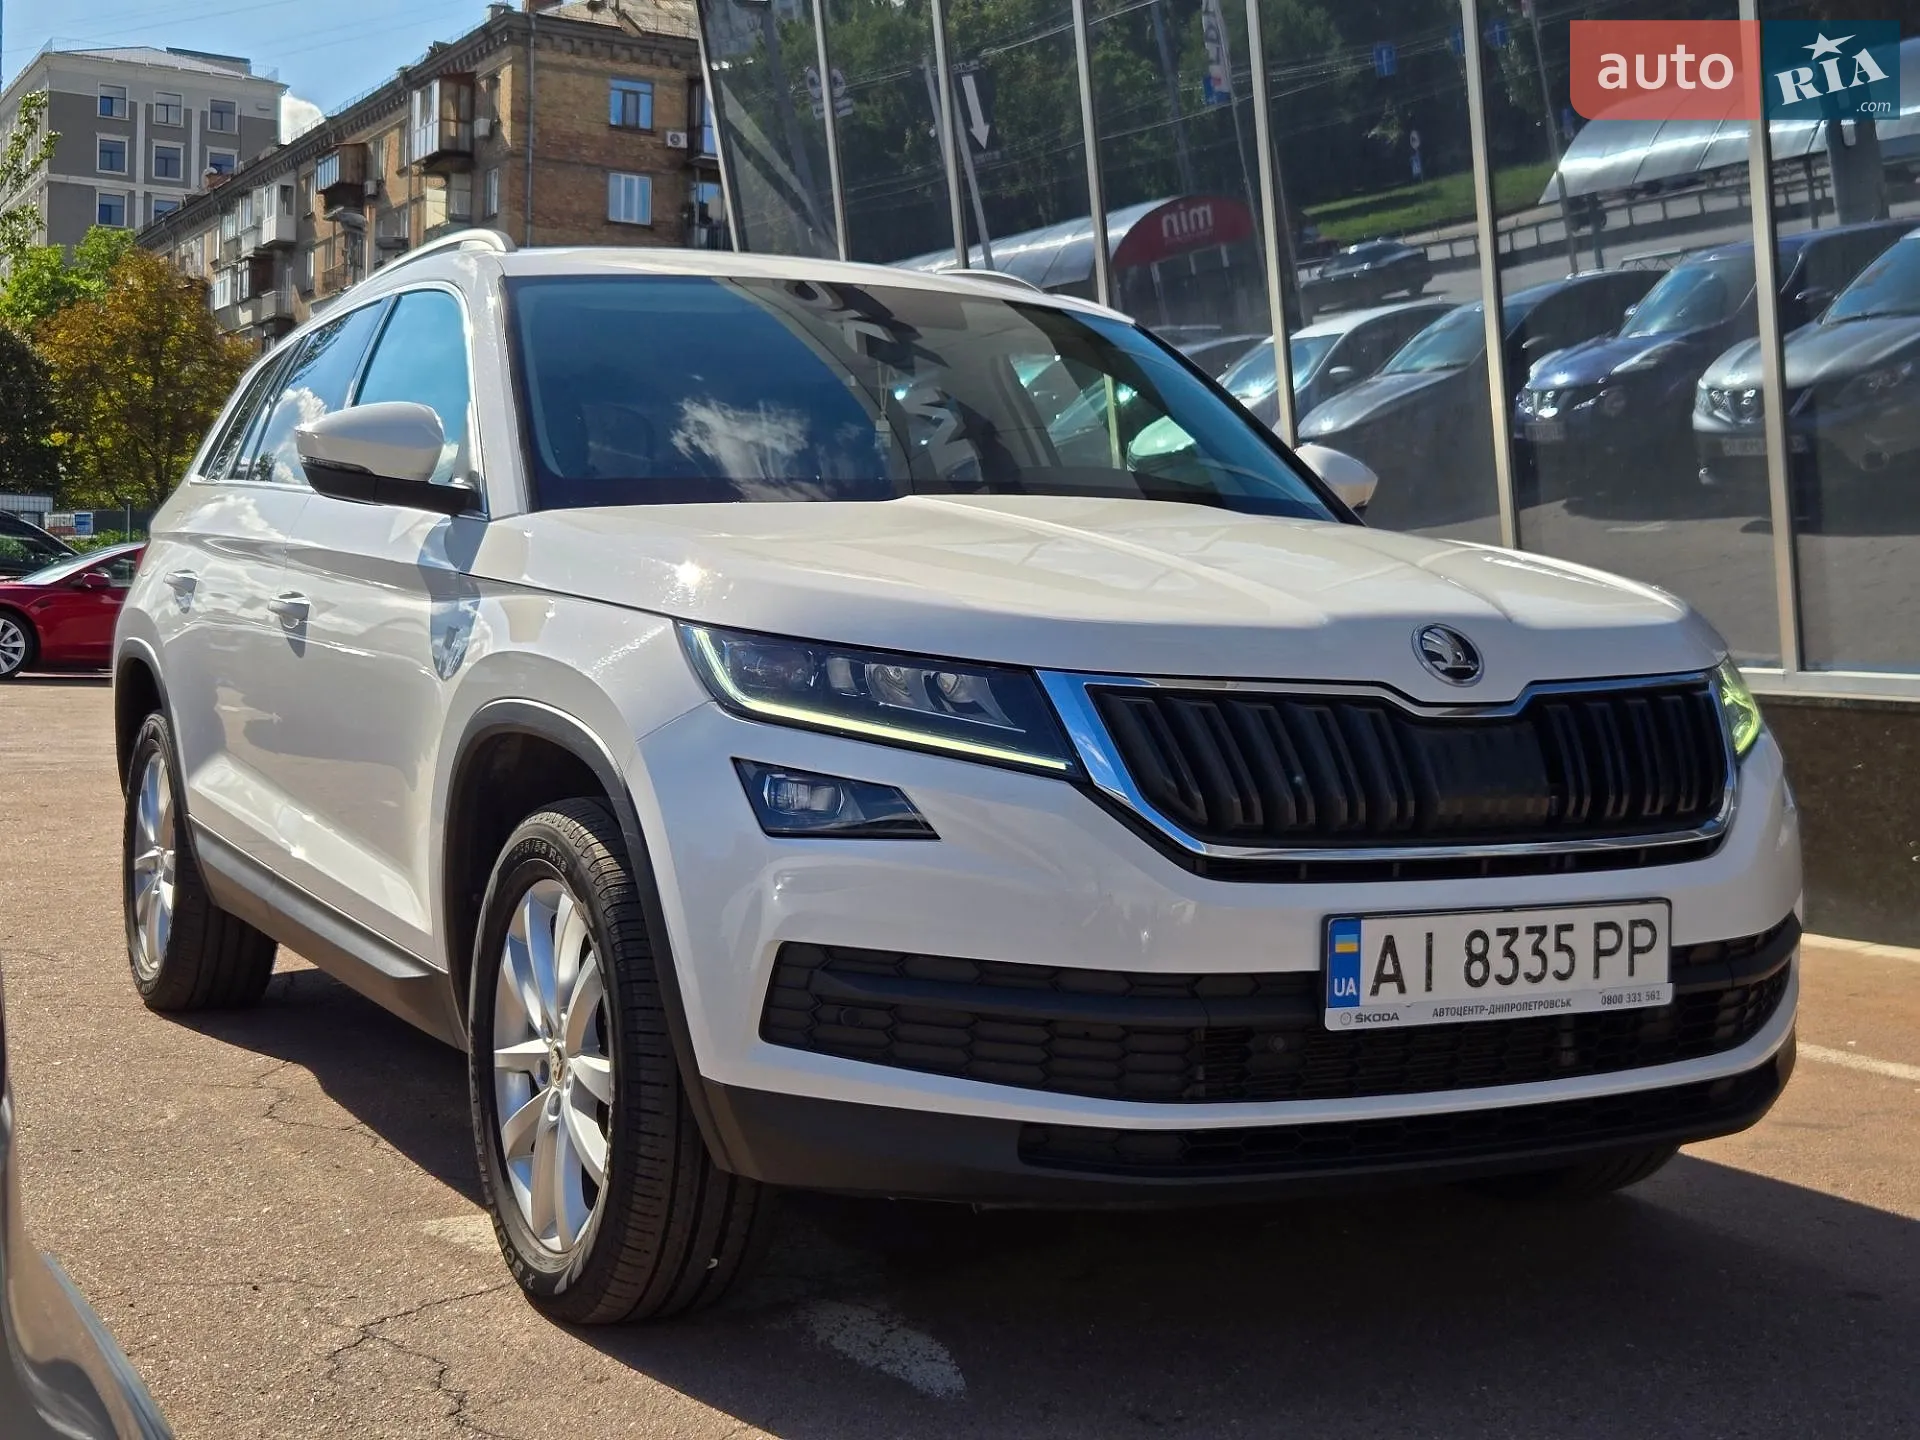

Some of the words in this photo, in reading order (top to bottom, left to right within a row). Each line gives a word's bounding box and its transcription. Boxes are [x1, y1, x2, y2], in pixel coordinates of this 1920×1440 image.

[1369, 931, 1434, 996] AI
[1463, 923, 1576, 988] 8335
[1593, 918, 1658, 980] PP
[1333, 976, 1358, 997] UA
[1601, 993, 1624, 1007] 0800
[1354, 1010, 1400, 1024] ŠKODA
